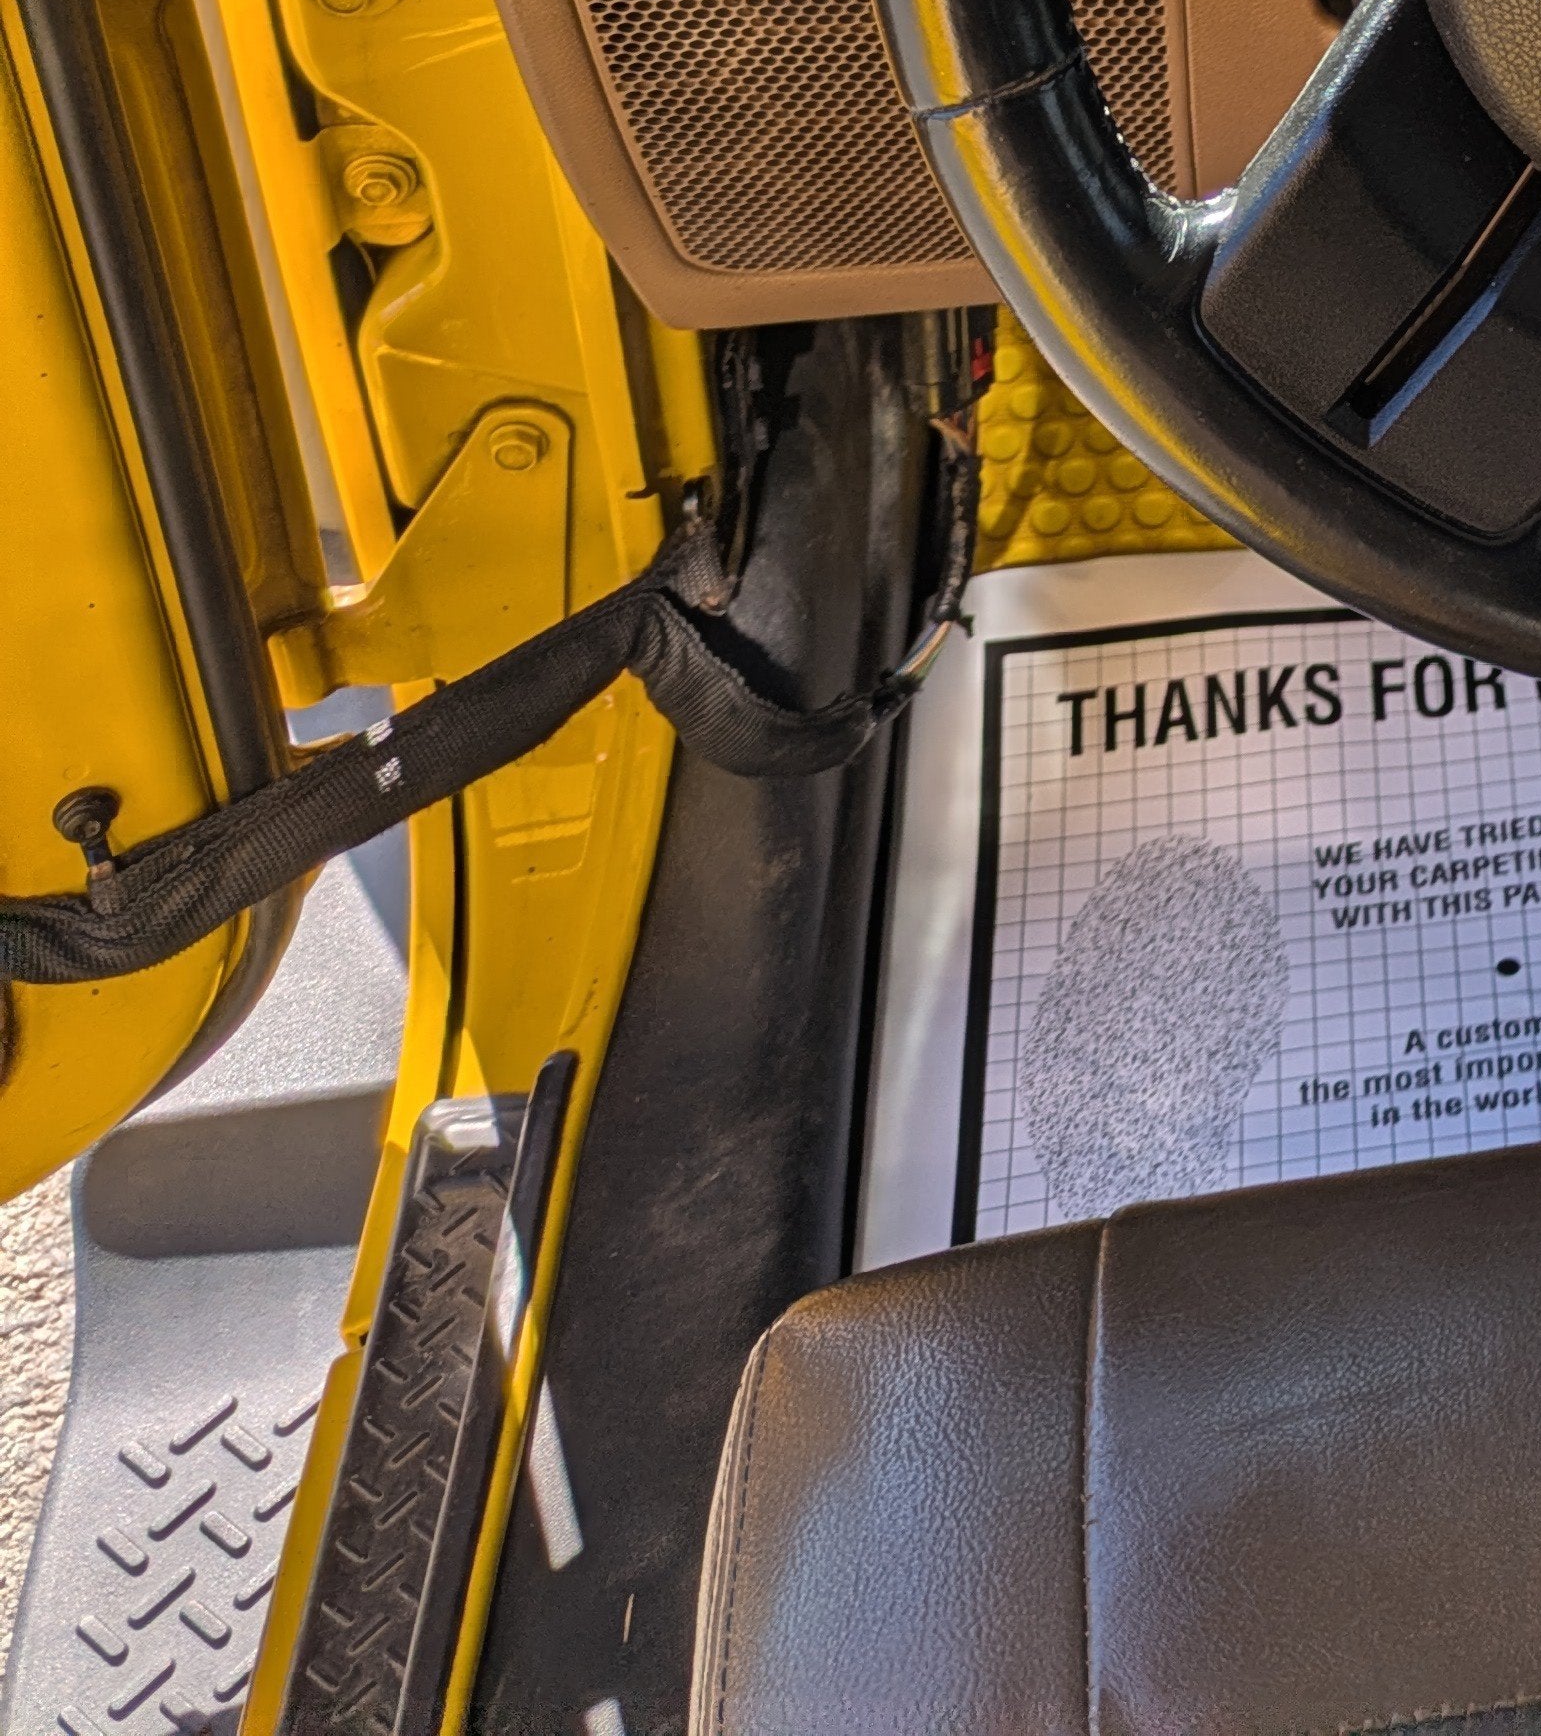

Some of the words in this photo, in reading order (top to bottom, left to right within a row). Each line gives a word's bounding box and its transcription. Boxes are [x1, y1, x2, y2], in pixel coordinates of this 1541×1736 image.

[1056, 662, 1344, 757] THANKS
[1370, 654, 1508, 724] FOR
[1315, 840, 1364, 870] WE
[1372, 828, 1452, 862] HAVE
[1311, 868, 1399, 900] YOUR
[1330, 898, 1413, 930] WITH
[1415, 886, 1494, 920] THIS
[1403, 1030, 1427, 1056] A
[1299, 1076, 1352, 1106] the
[1362, 1062, 1443, 1098] most
[1369, 1103, 1402, 1129] in
[1411, 1093, 1464, 1122] the
